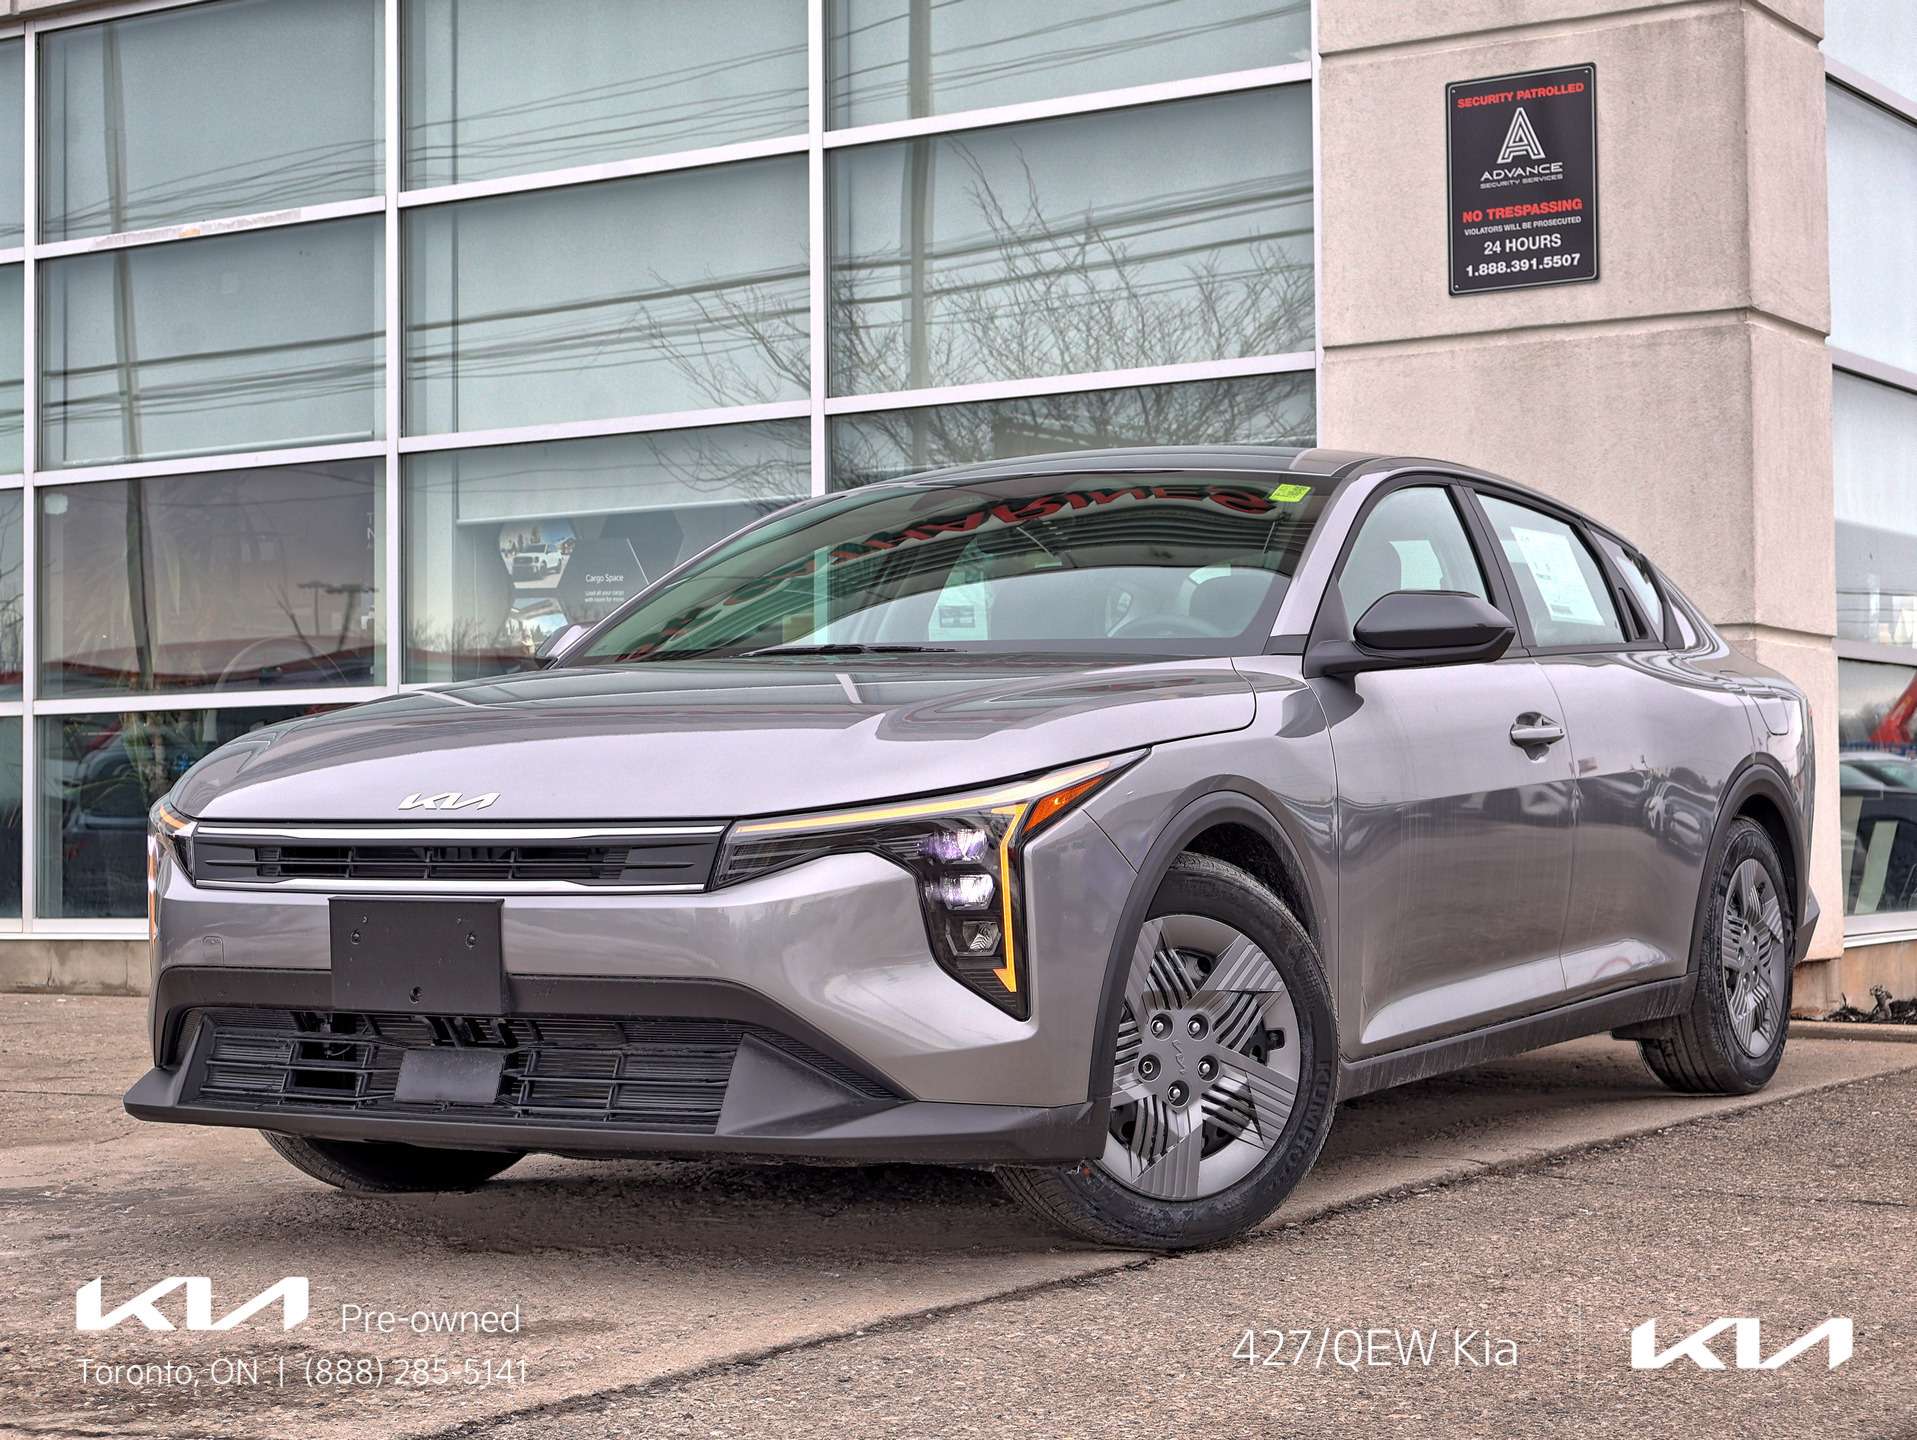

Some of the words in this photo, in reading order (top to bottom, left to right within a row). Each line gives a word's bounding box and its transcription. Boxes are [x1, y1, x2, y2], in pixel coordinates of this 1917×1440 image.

[1457, 91, 1514, 108] SECURITY
[1516, 83, 1585, 100] PATROLLED
[1480, 162, 1563, 181] ADVANCE
[1480, 179, 1520, 189] SECURITY
[1522, 173, 1564, 185] SERVICES
[1462, 209, 1483, 223] NO
[1486, 198, 1583, 220] TRESPASSING
[1464, 225, 1503, 236] VIOLATORS
[1504, 222, 1521, 232] WILL
[1522, 221, 1532, 230] BE
[1533, 216, 1582, 228] PROSECUTED
[1483, 240, 1502, 255] 24
[1505, 233, 1562, 253] HOURS
[1466, 253, 1581, 277] 1.888.391.5507
[585, 574, 604, 584] Cargo
[605, 574, 624, 583] Space
